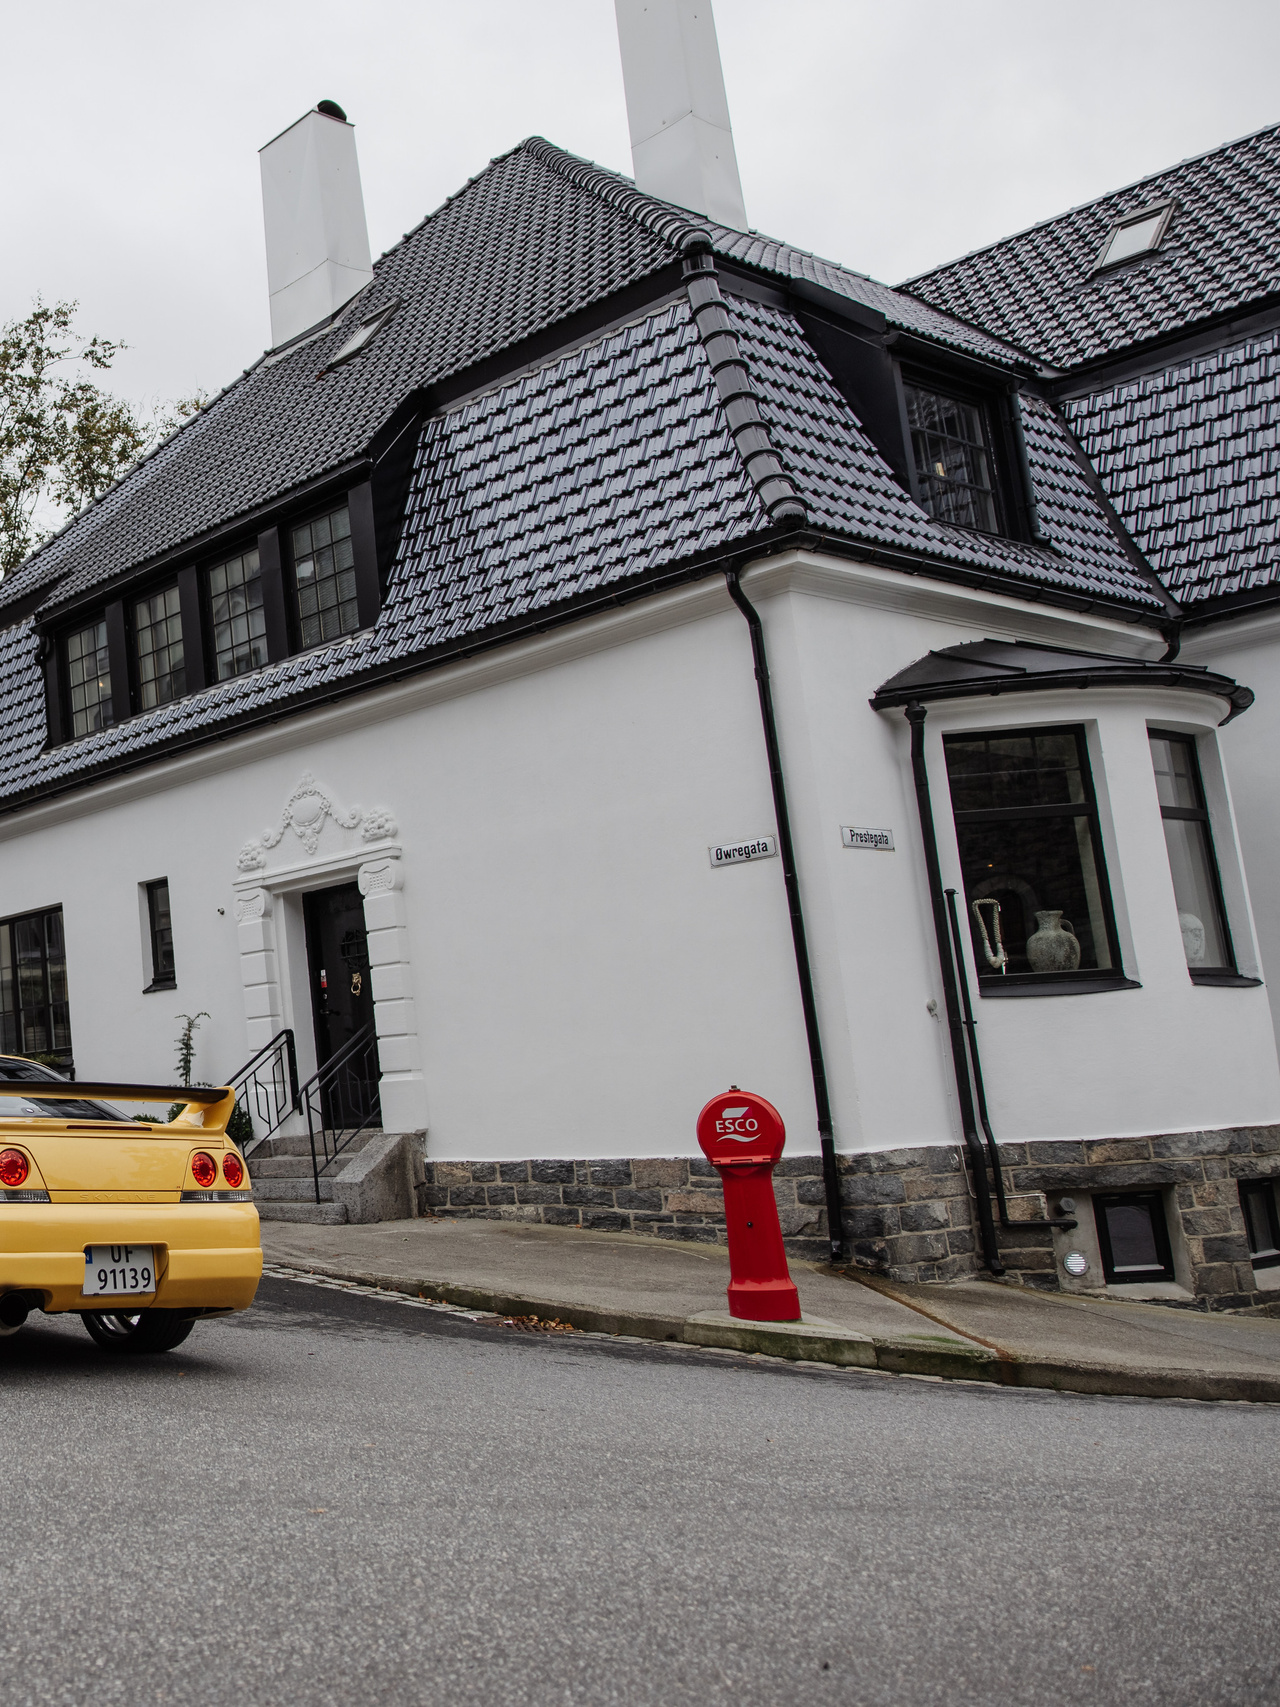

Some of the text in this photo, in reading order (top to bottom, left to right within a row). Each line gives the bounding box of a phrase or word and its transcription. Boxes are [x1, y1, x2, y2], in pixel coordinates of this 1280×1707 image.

[849, 829, 889, 847] Prestegata
[715, 840, 768, 861] Øwregata
[715, 1118, 758, 1133] ESCO
[79, 1193, 156, 1202] SKYLINE
[97, 1267, 151, 1290] 91139
